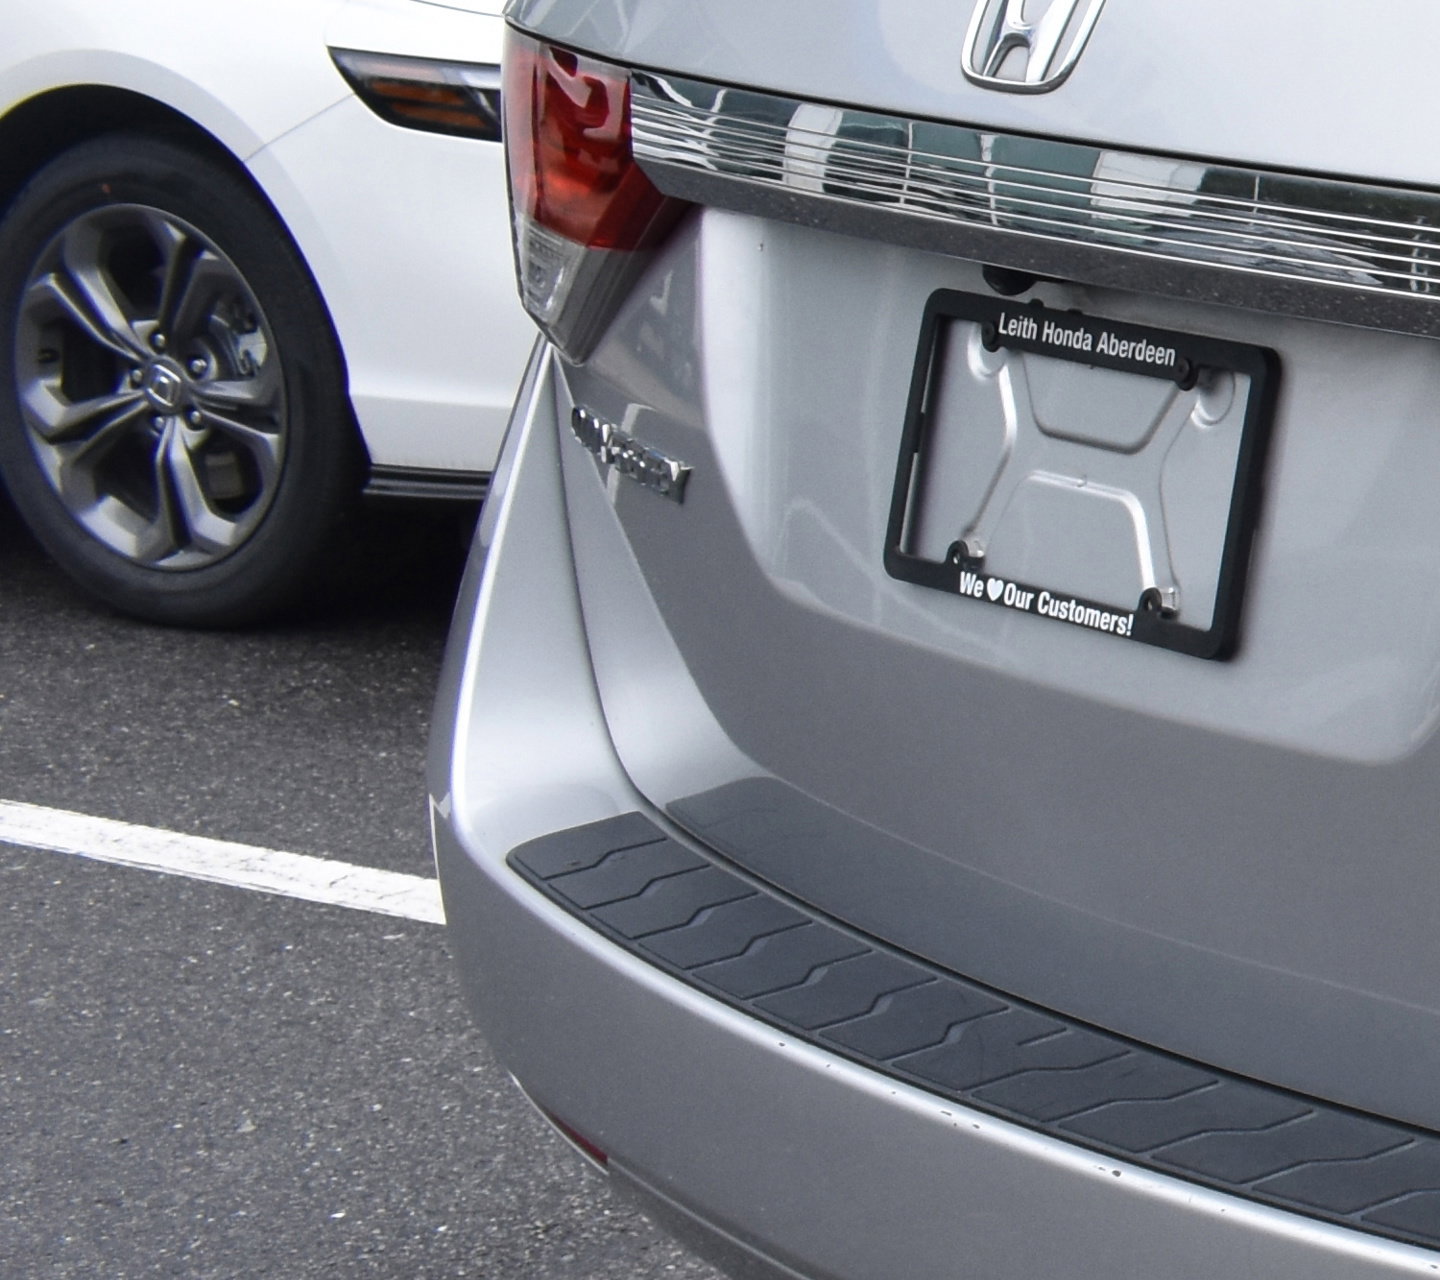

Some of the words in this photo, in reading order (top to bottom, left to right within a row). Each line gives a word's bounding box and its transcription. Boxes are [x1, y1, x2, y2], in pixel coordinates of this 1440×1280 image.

[998, 312, 1038, 341] Leith
[1041, 320, 1093, 352] Honda
[1096, 331, 1177, 367] Aberdeen
[959, 571, 985, 598] We
[1003, 582, 1035, 611] Our
[1037, 591, 1135, 637] Customers!
